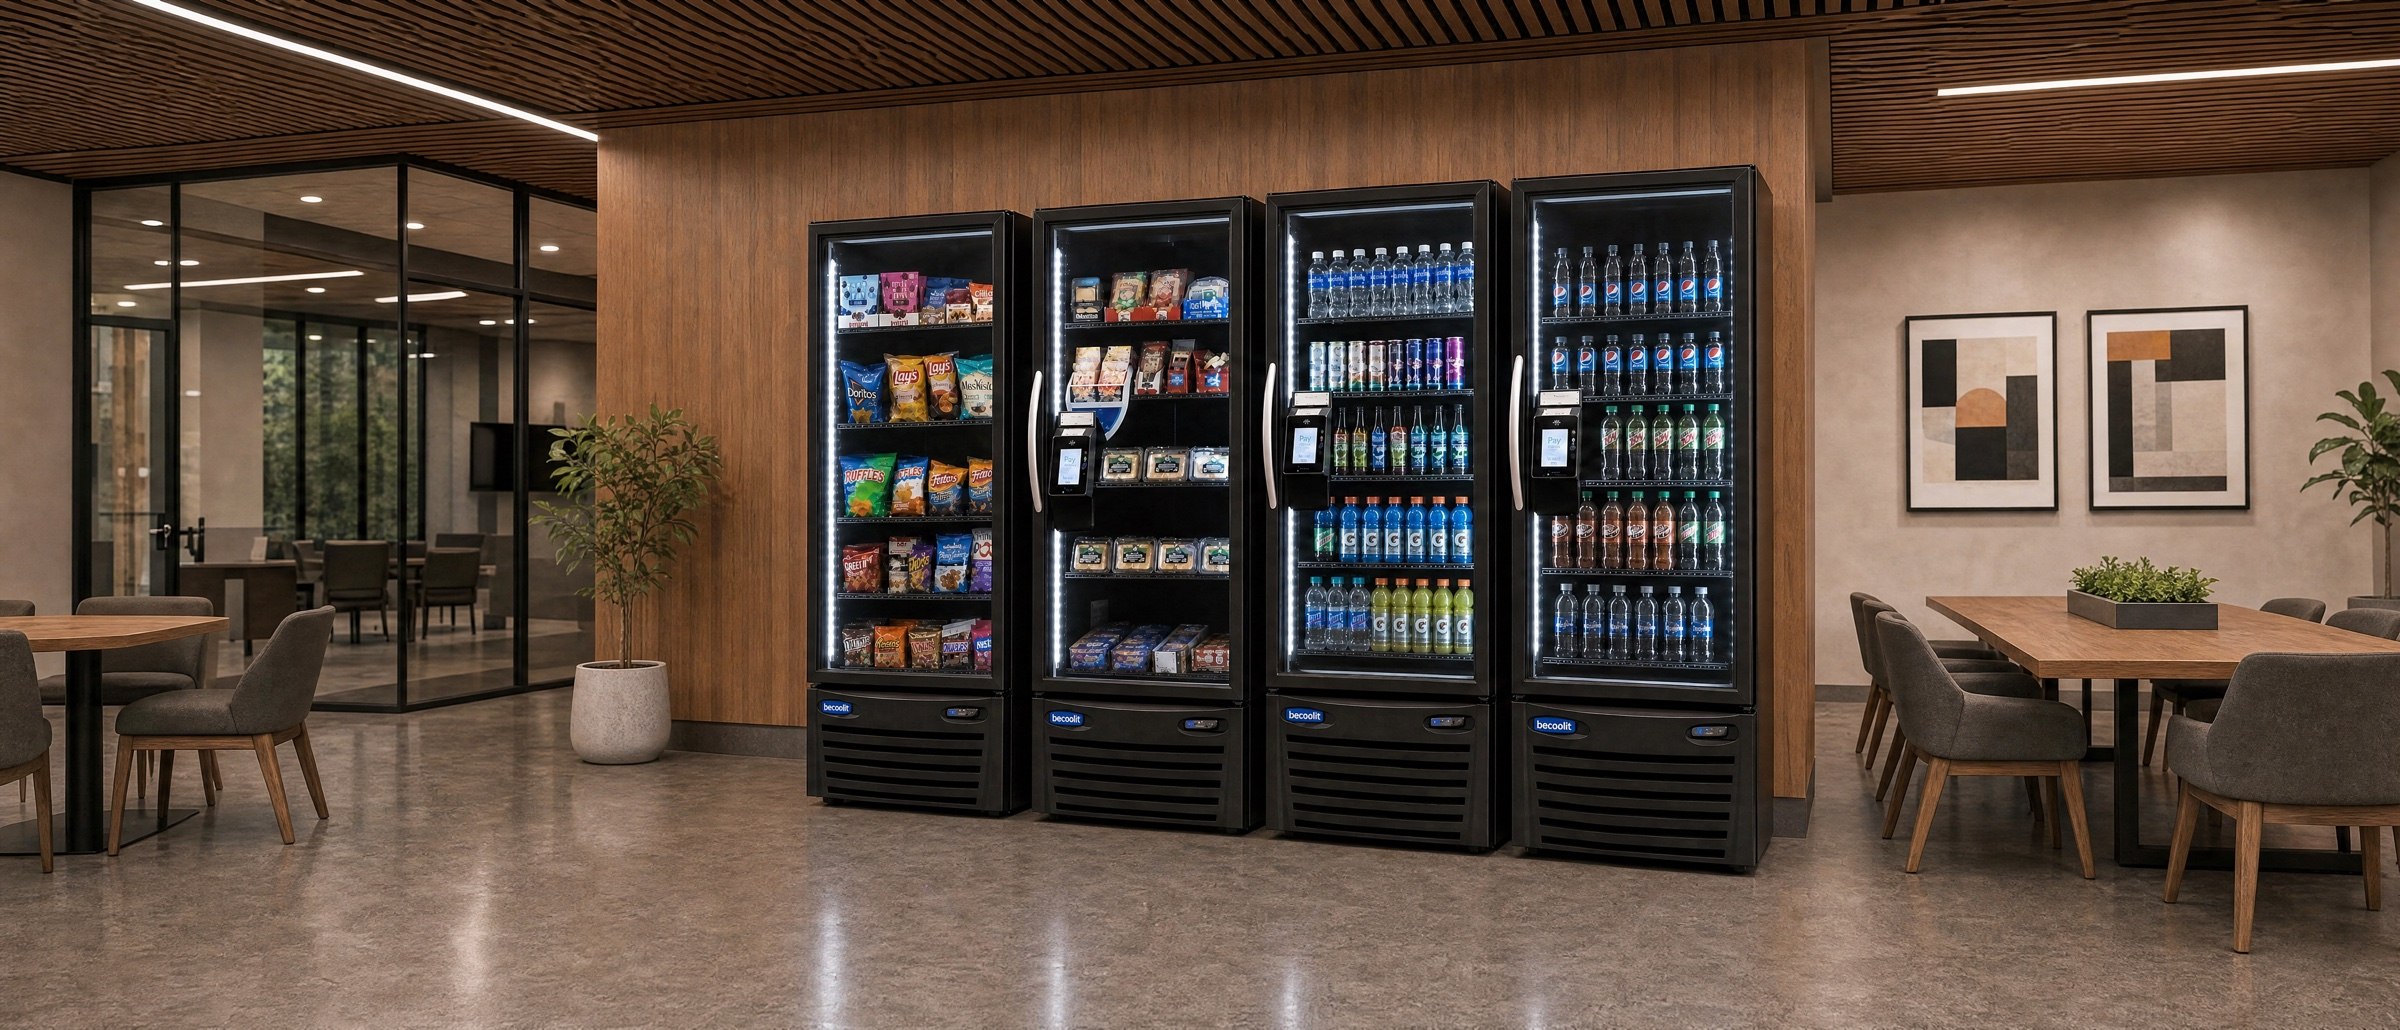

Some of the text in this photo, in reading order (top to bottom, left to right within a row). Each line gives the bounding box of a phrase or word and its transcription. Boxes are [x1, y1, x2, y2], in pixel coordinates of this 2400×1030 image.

[929, 361, 951, 376] Lay's
[894, 369, 918, 385] Lay's
[848, 387, 877, 399] Doritos
[1547, 437, 1562, 445] Pay
[1064, 456, 1076, 464] Pay
[844, 468, 885, 484] RUFFLES
[823, 703, 849, 712] becoolit
[1051, 713, 1081, 723] becoolit
[1288, 710, 1321, 721] becoolit
[1536, 720, 1572, 731] becoolit
